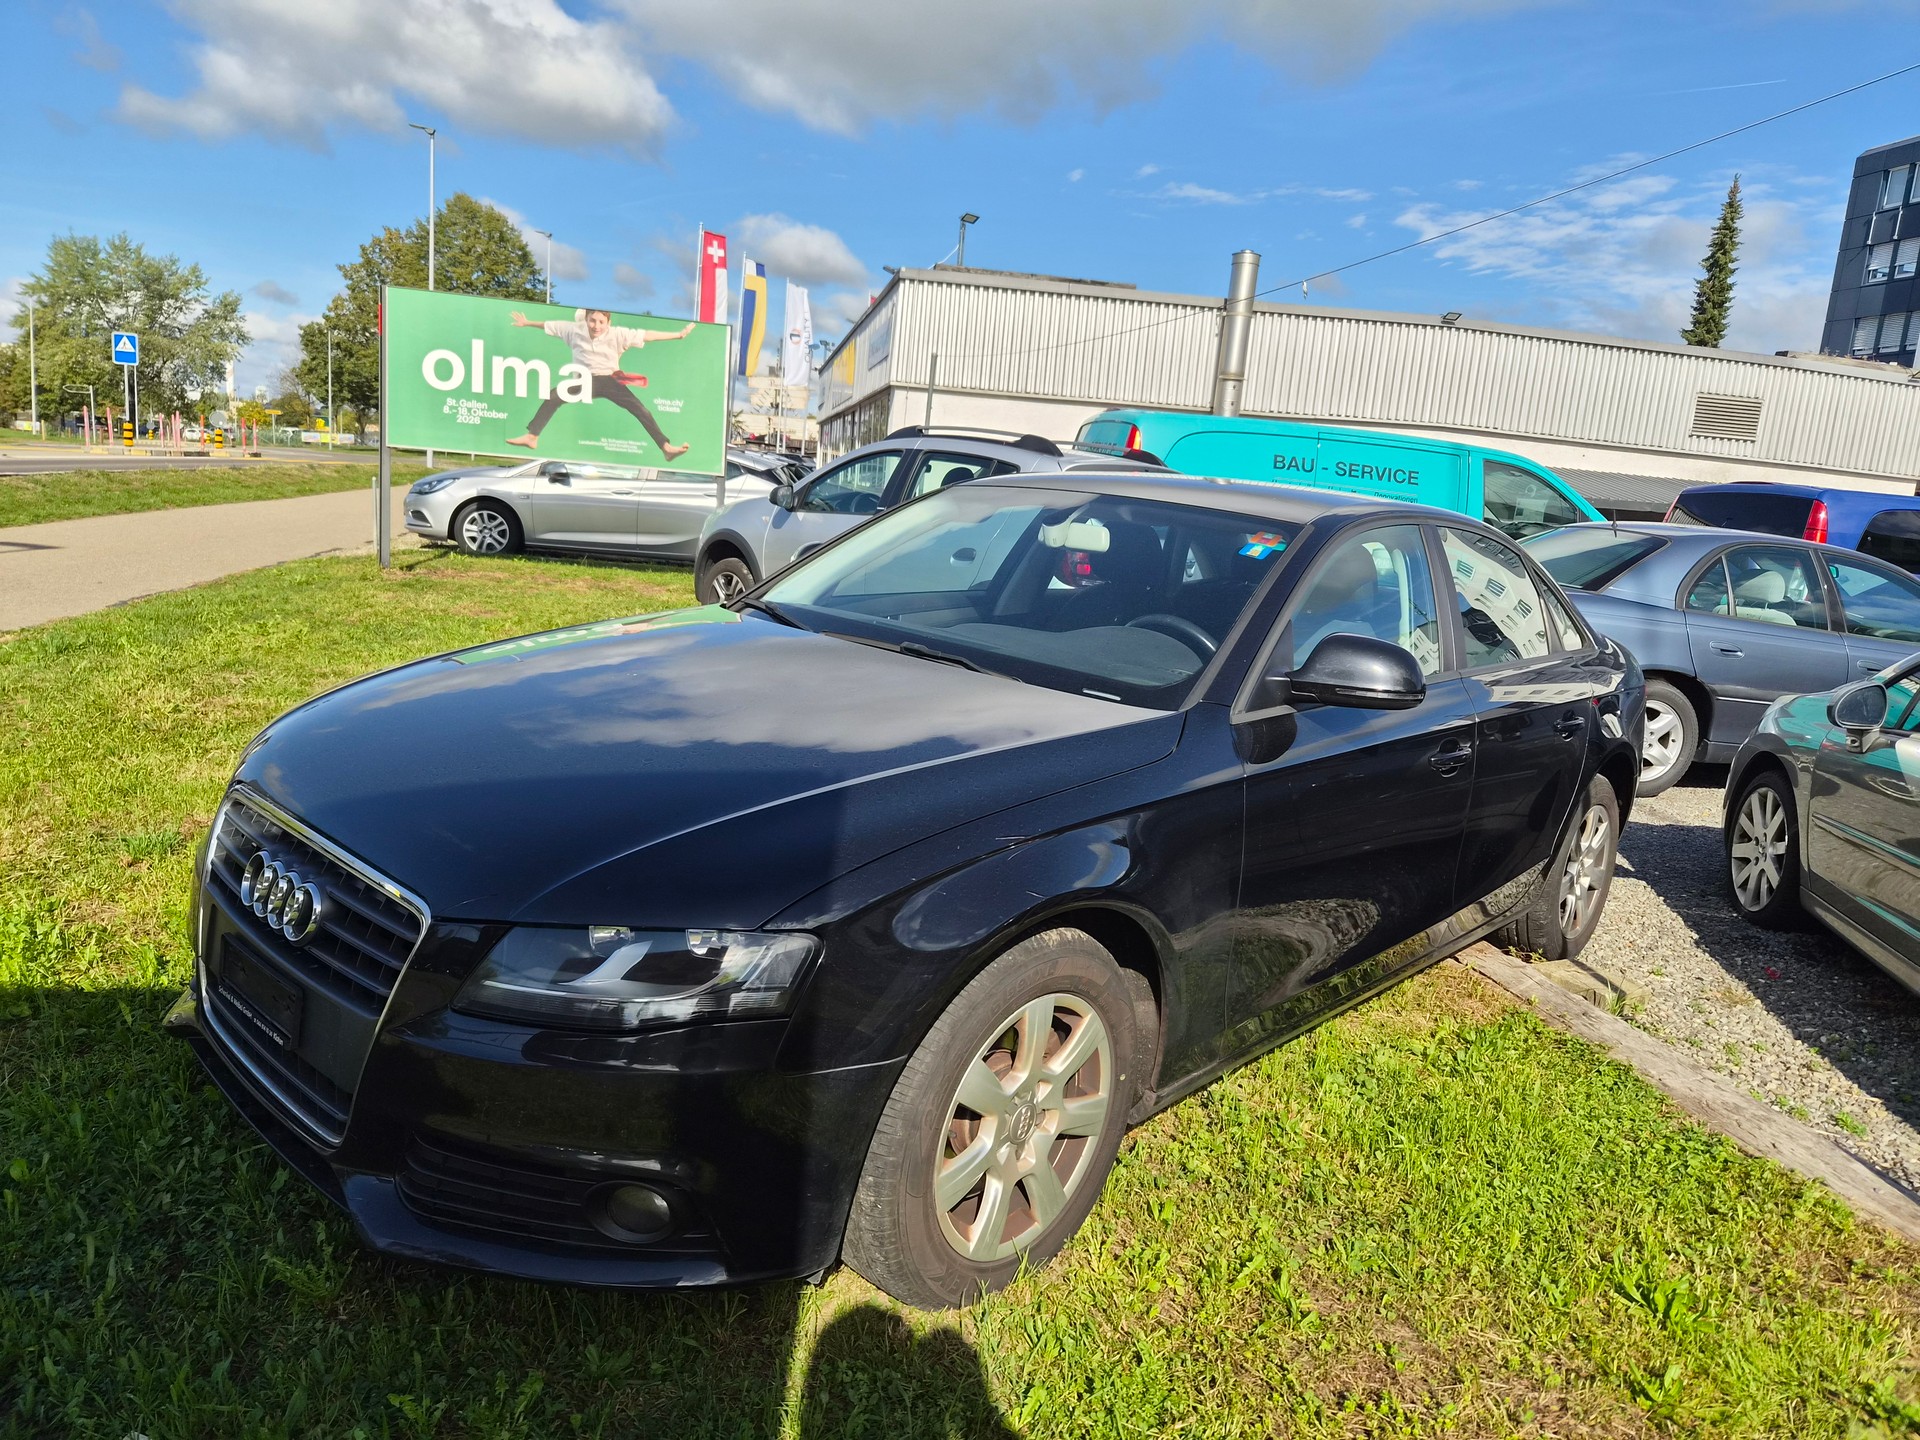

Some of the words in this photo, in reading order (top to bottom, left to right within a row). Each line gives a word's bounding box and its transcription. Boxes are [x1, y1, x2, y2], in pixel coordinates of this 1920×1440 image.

[422, 338, 593, 404] olma
[447, 397, 459, 407] St.
[459, 398, 488, 410] Gallen
[657, 405, 681, 413] tickets
[471, 407, 508, 419] Oktober
[456, 414, 481, 425] 2026
[1273, 454, 1315, 473] BAU
[1335, 461, 1420, 486] SERVICE
